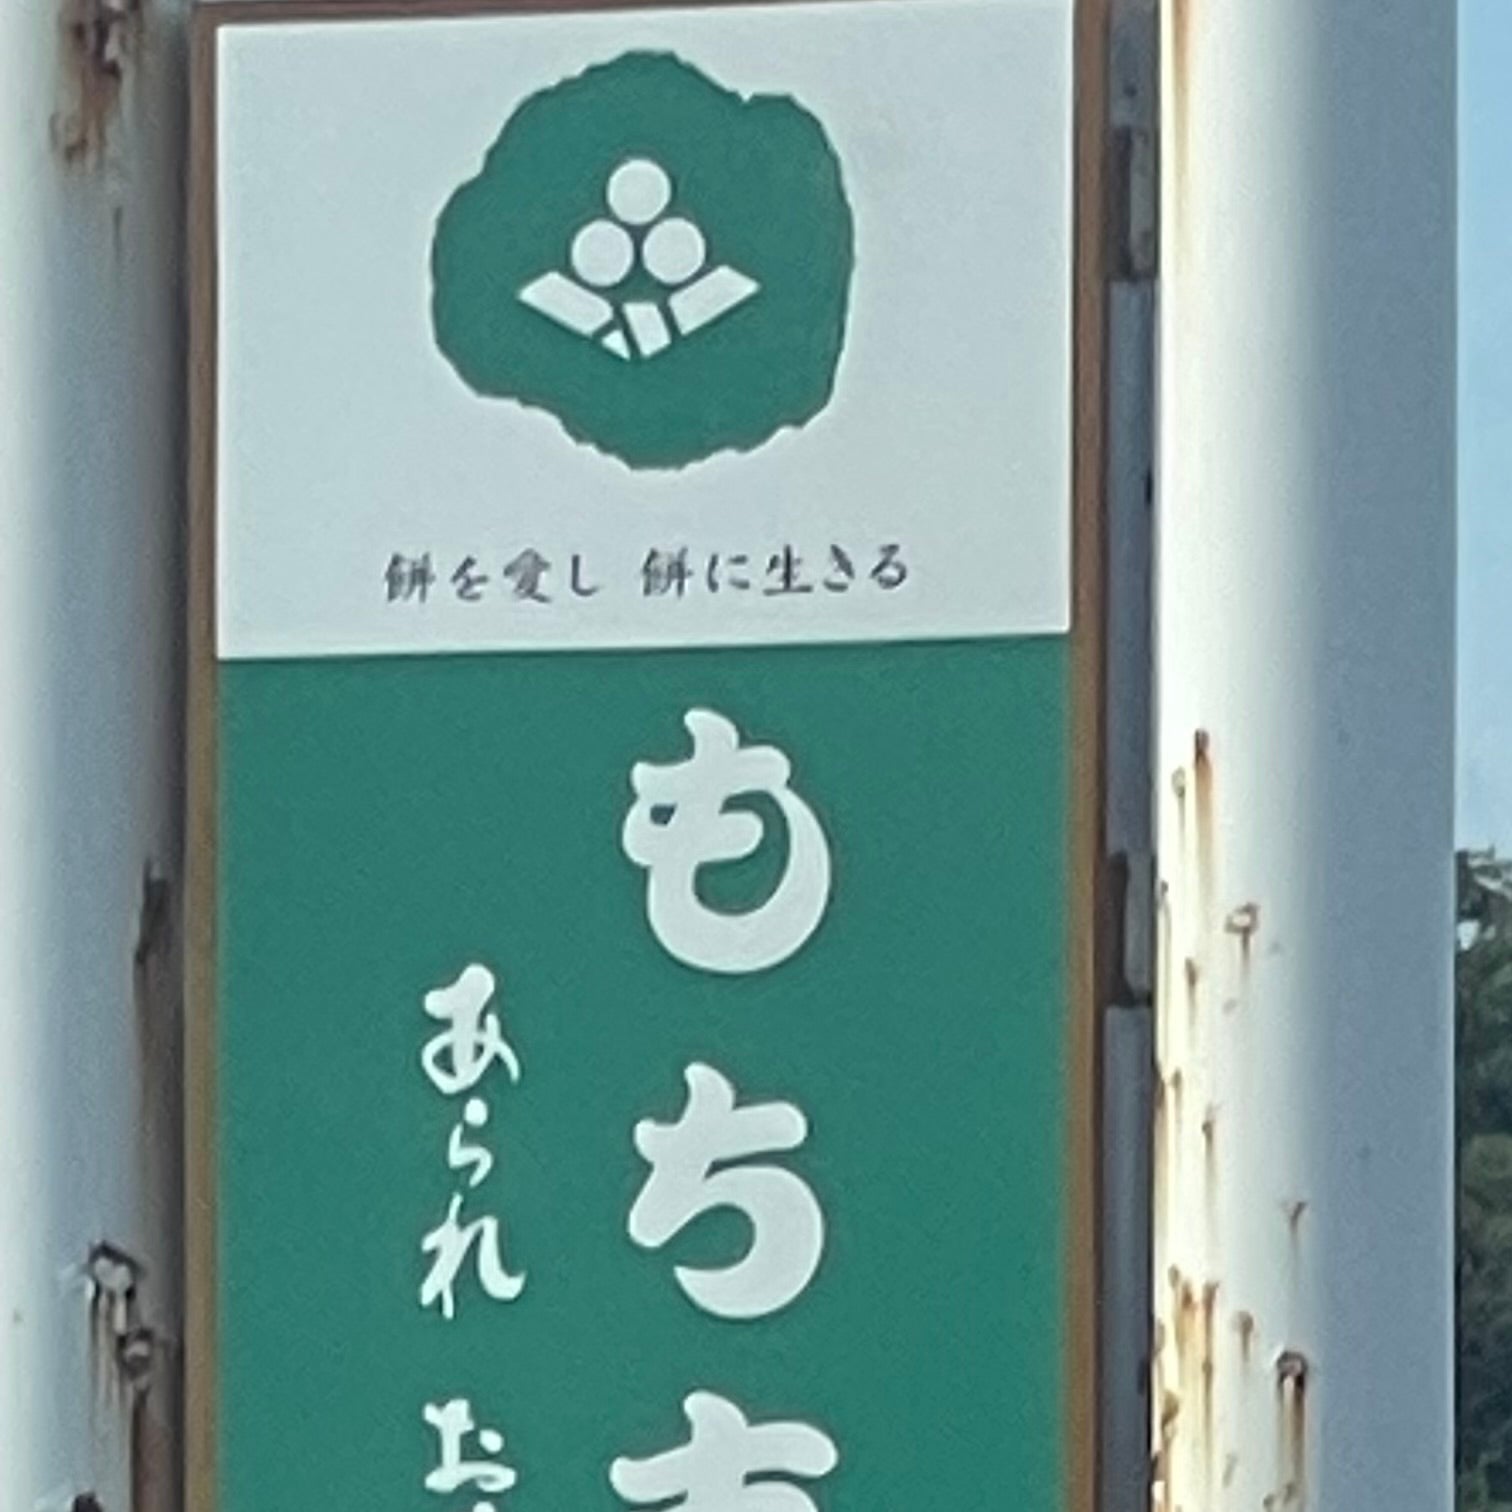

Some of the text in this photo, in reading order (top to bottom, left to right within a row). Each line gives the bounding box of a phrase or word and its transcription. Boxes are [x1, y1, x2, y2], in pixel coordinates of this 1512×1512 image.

[641, 543, 908, 598] 餅に生きる
[420, 963, 526, 1319] あられ
